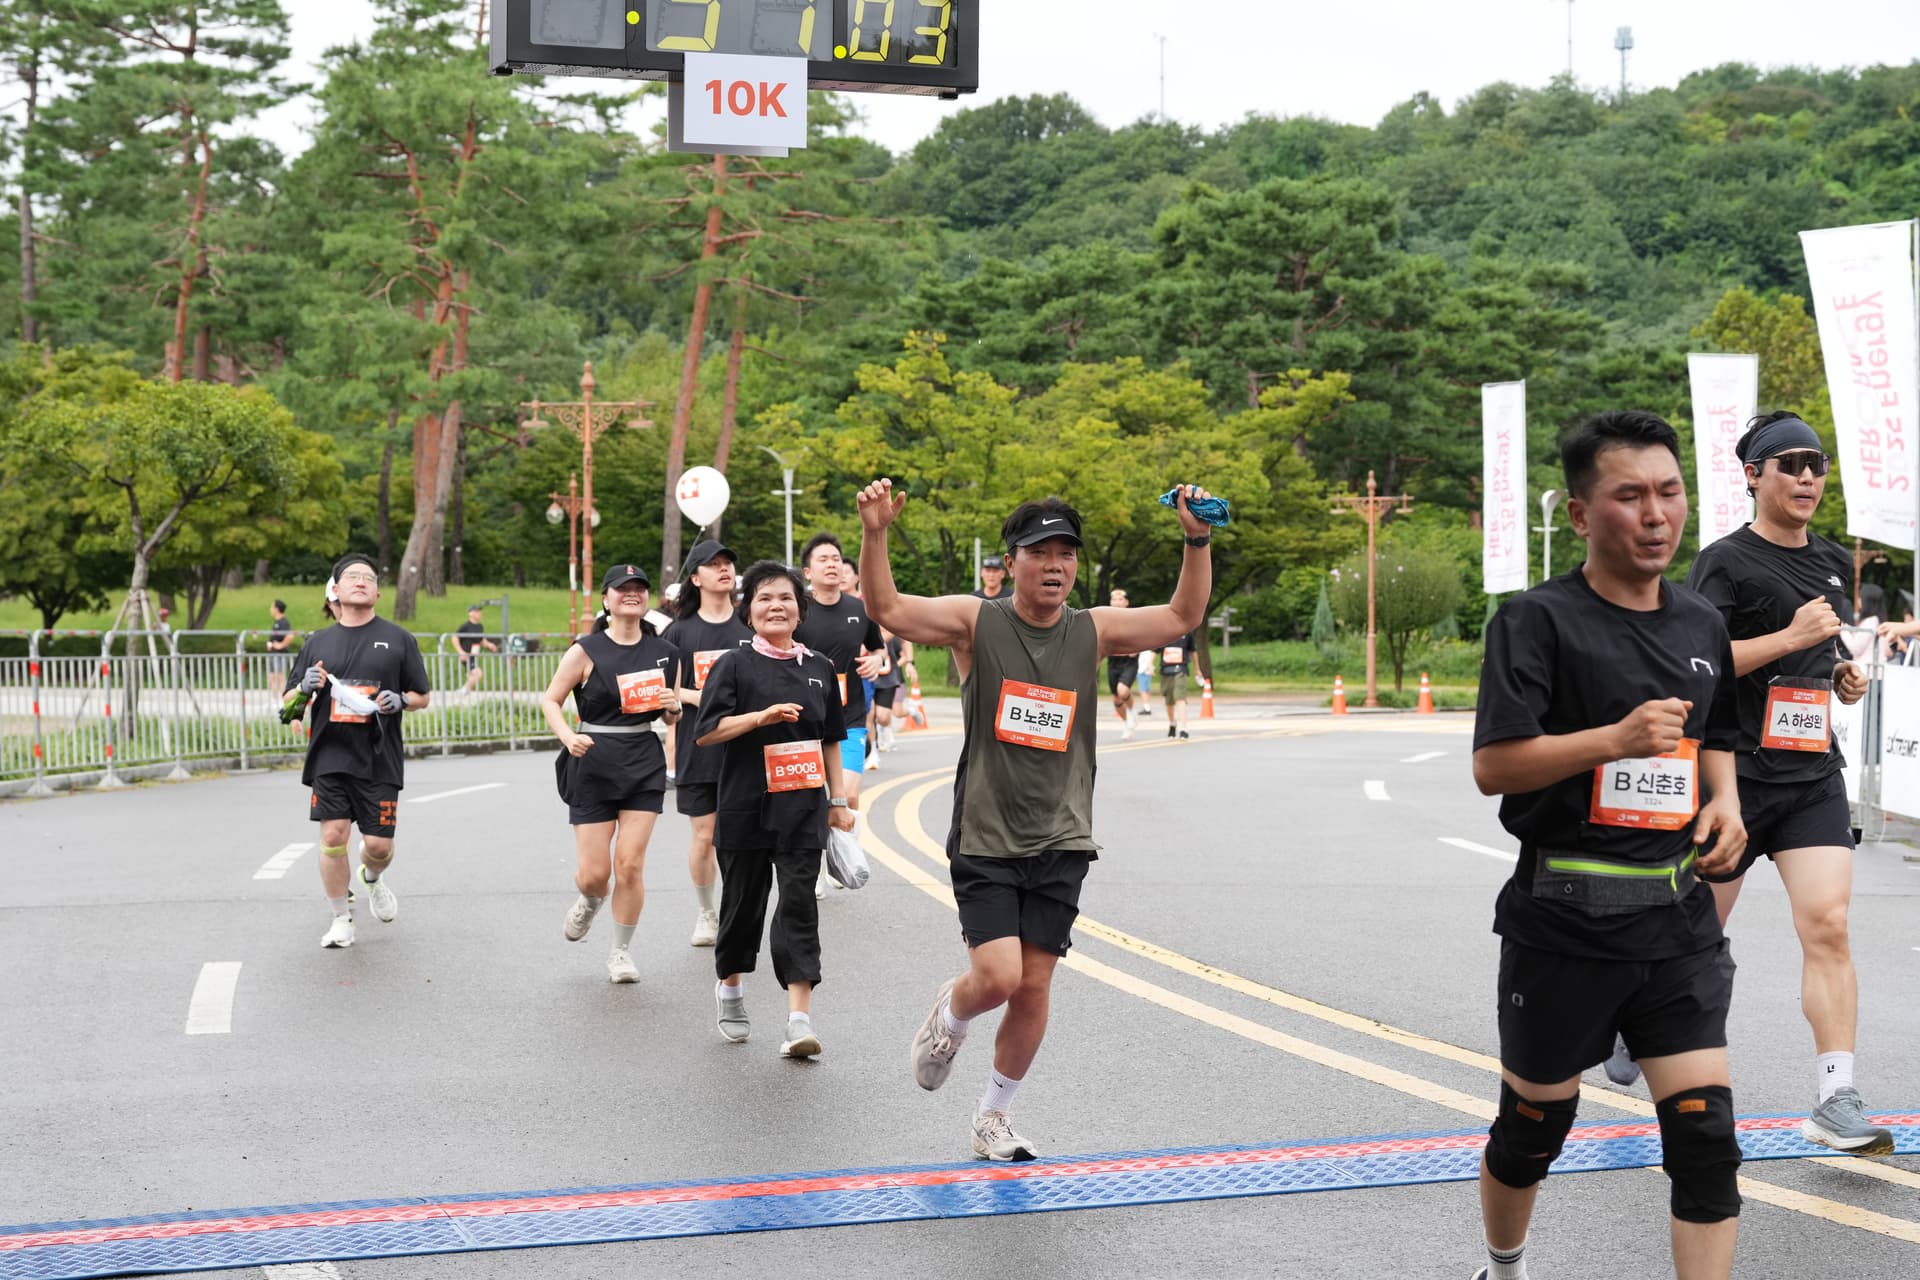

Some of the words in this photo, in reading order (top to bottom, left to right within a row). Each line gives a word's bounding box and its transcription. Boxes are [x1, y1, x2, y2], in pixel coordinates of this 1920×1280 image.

[704, 79, 788, 118] 10K
[1009, 706, 1022, 720] B
[1024, 708, 1064, 729] 노창군
[1777, 713, 1789, 726] A
[775, 765, 785, 777] B
[786, 762, 817, 776] 9008
[1614, 771, 1631, 791] B
[1636, 772, 1687, 795] 신춘호
